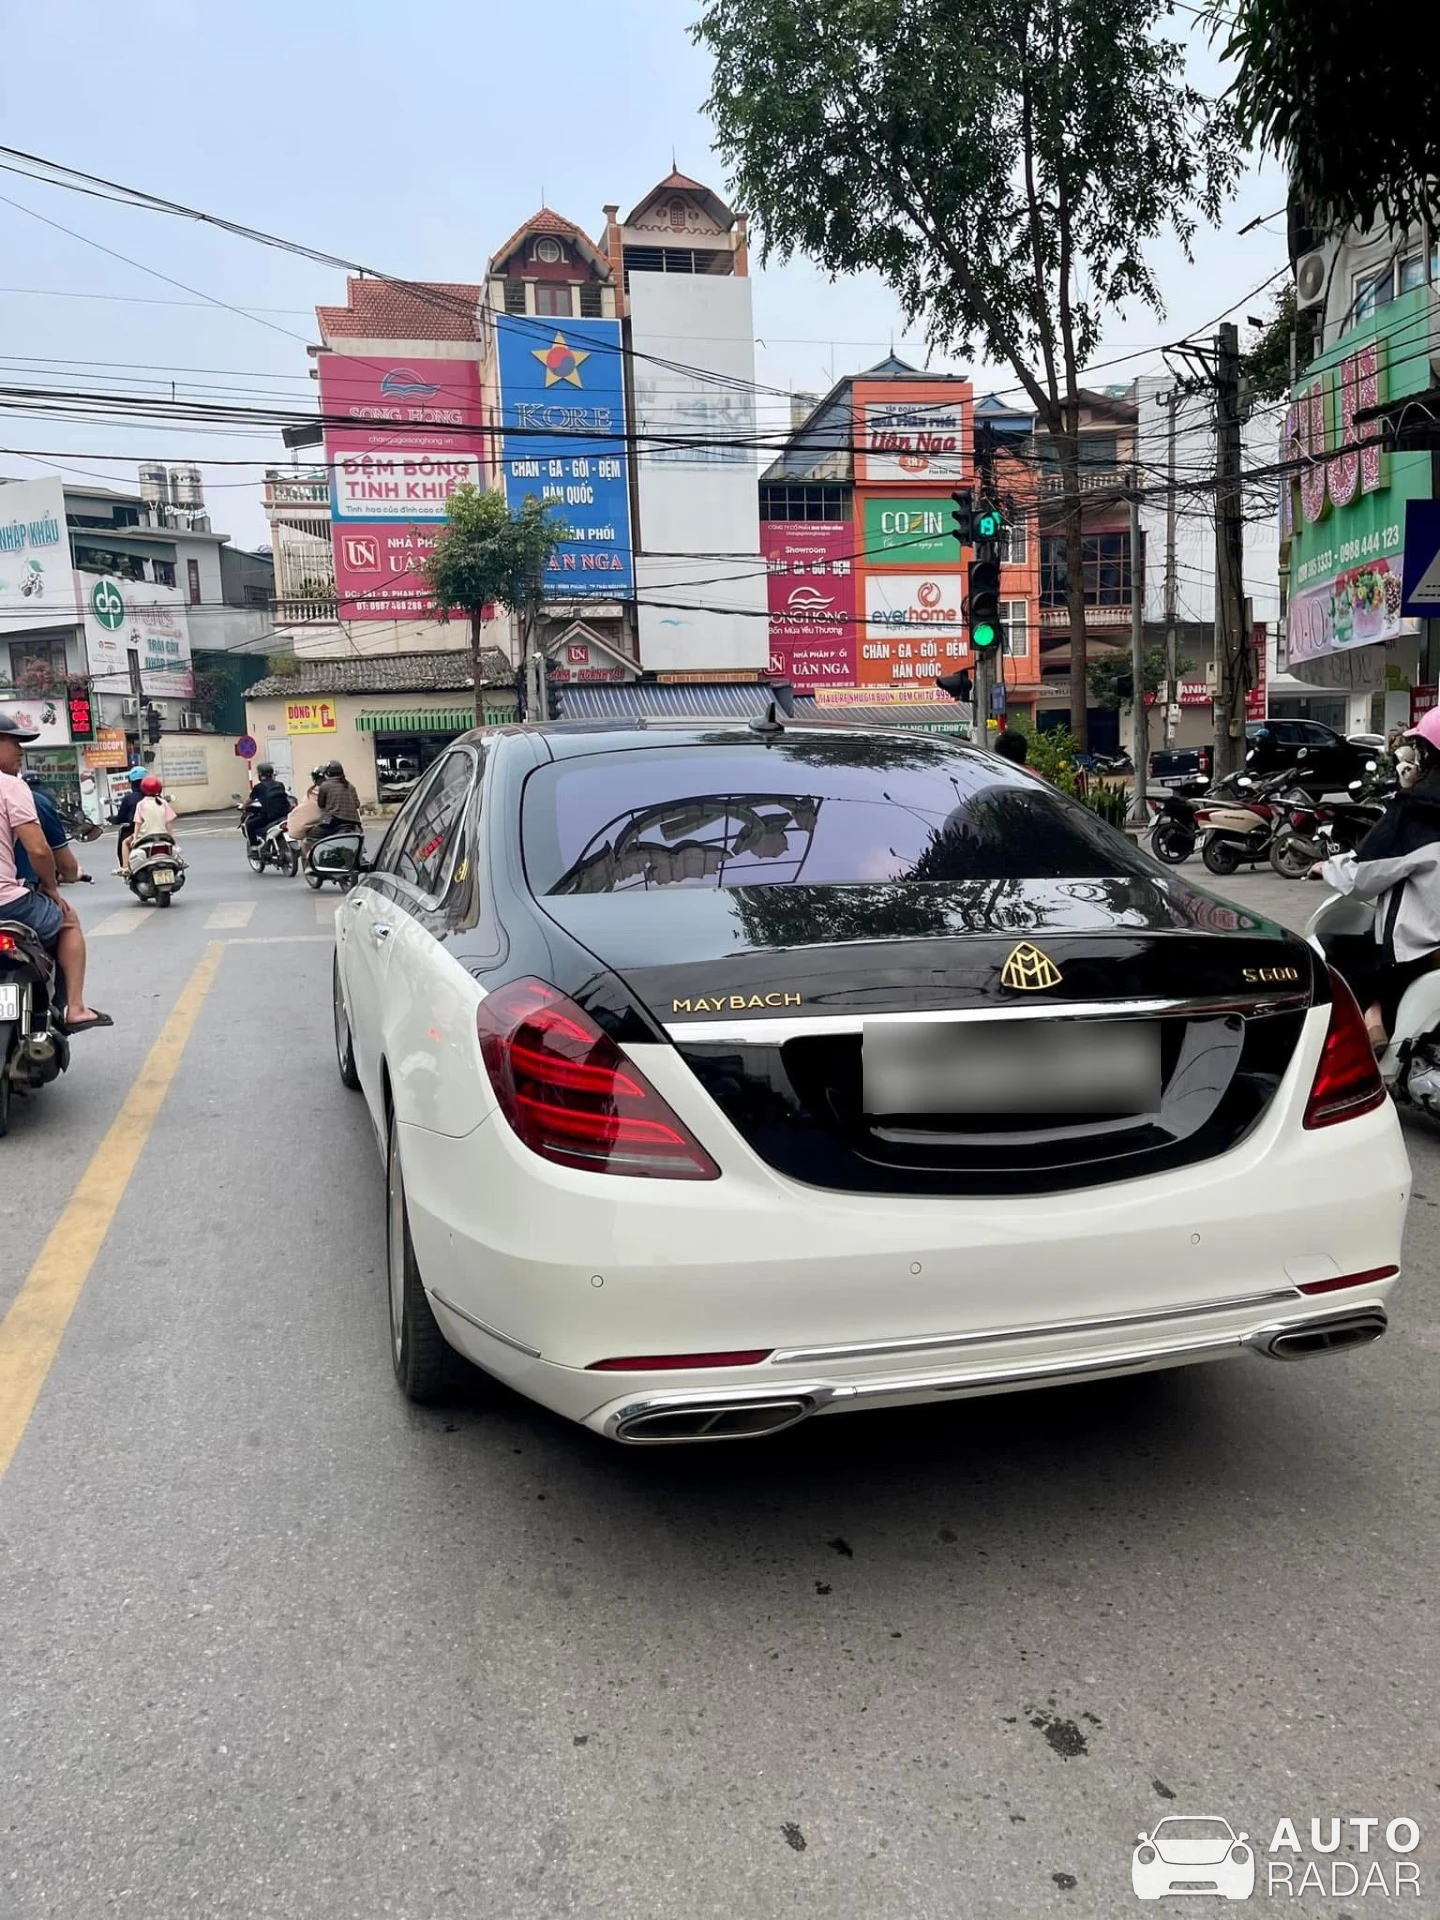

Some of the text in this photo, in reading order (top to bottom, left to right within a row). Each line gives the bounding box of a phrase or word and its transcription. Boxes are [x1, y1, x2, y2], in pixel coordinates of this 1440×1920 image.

[344, 455, 470, 479] ĐỆM BÔNG
[511, 455, 540, 477] CHĂN
[549, 459, 563, 478] GA
[599, 457, 621, 481] ĐỆM
[345, 481, 399, 499] TINH
[542, 480, 594, 505] HÀN QUỐC
[366, 505, 381, 514] hoa
[881, 511, 943, 534] COZIN
[980, 517, 994, 535] 19
[588, 524, 615, 540] PHỐI
[388, 536, 414, 548] NHÀ
[785, 546, 826, 554] Showroom
[1340, 539, 1360, 563] 0988
[1361, 531, 1380, 556] 444
[1382, 524, 1399, 549] 123
[581, 553, 624, 571] NGA
[832, 560, 851, 578] ĐỆM
[871, 606, 957, 623] everhome
[814, 626, 843, 635] Thương
[862, 638, 968, 659] CHĂN GA GỐI ĐỆM
[793, 661, 850, 675] UÂN NGA
[892, 659, 942, 678] HÀN QUỐC
[1243, 967, 1299, 984] S600
[673, 991, 802, 1013] MAYBACH
